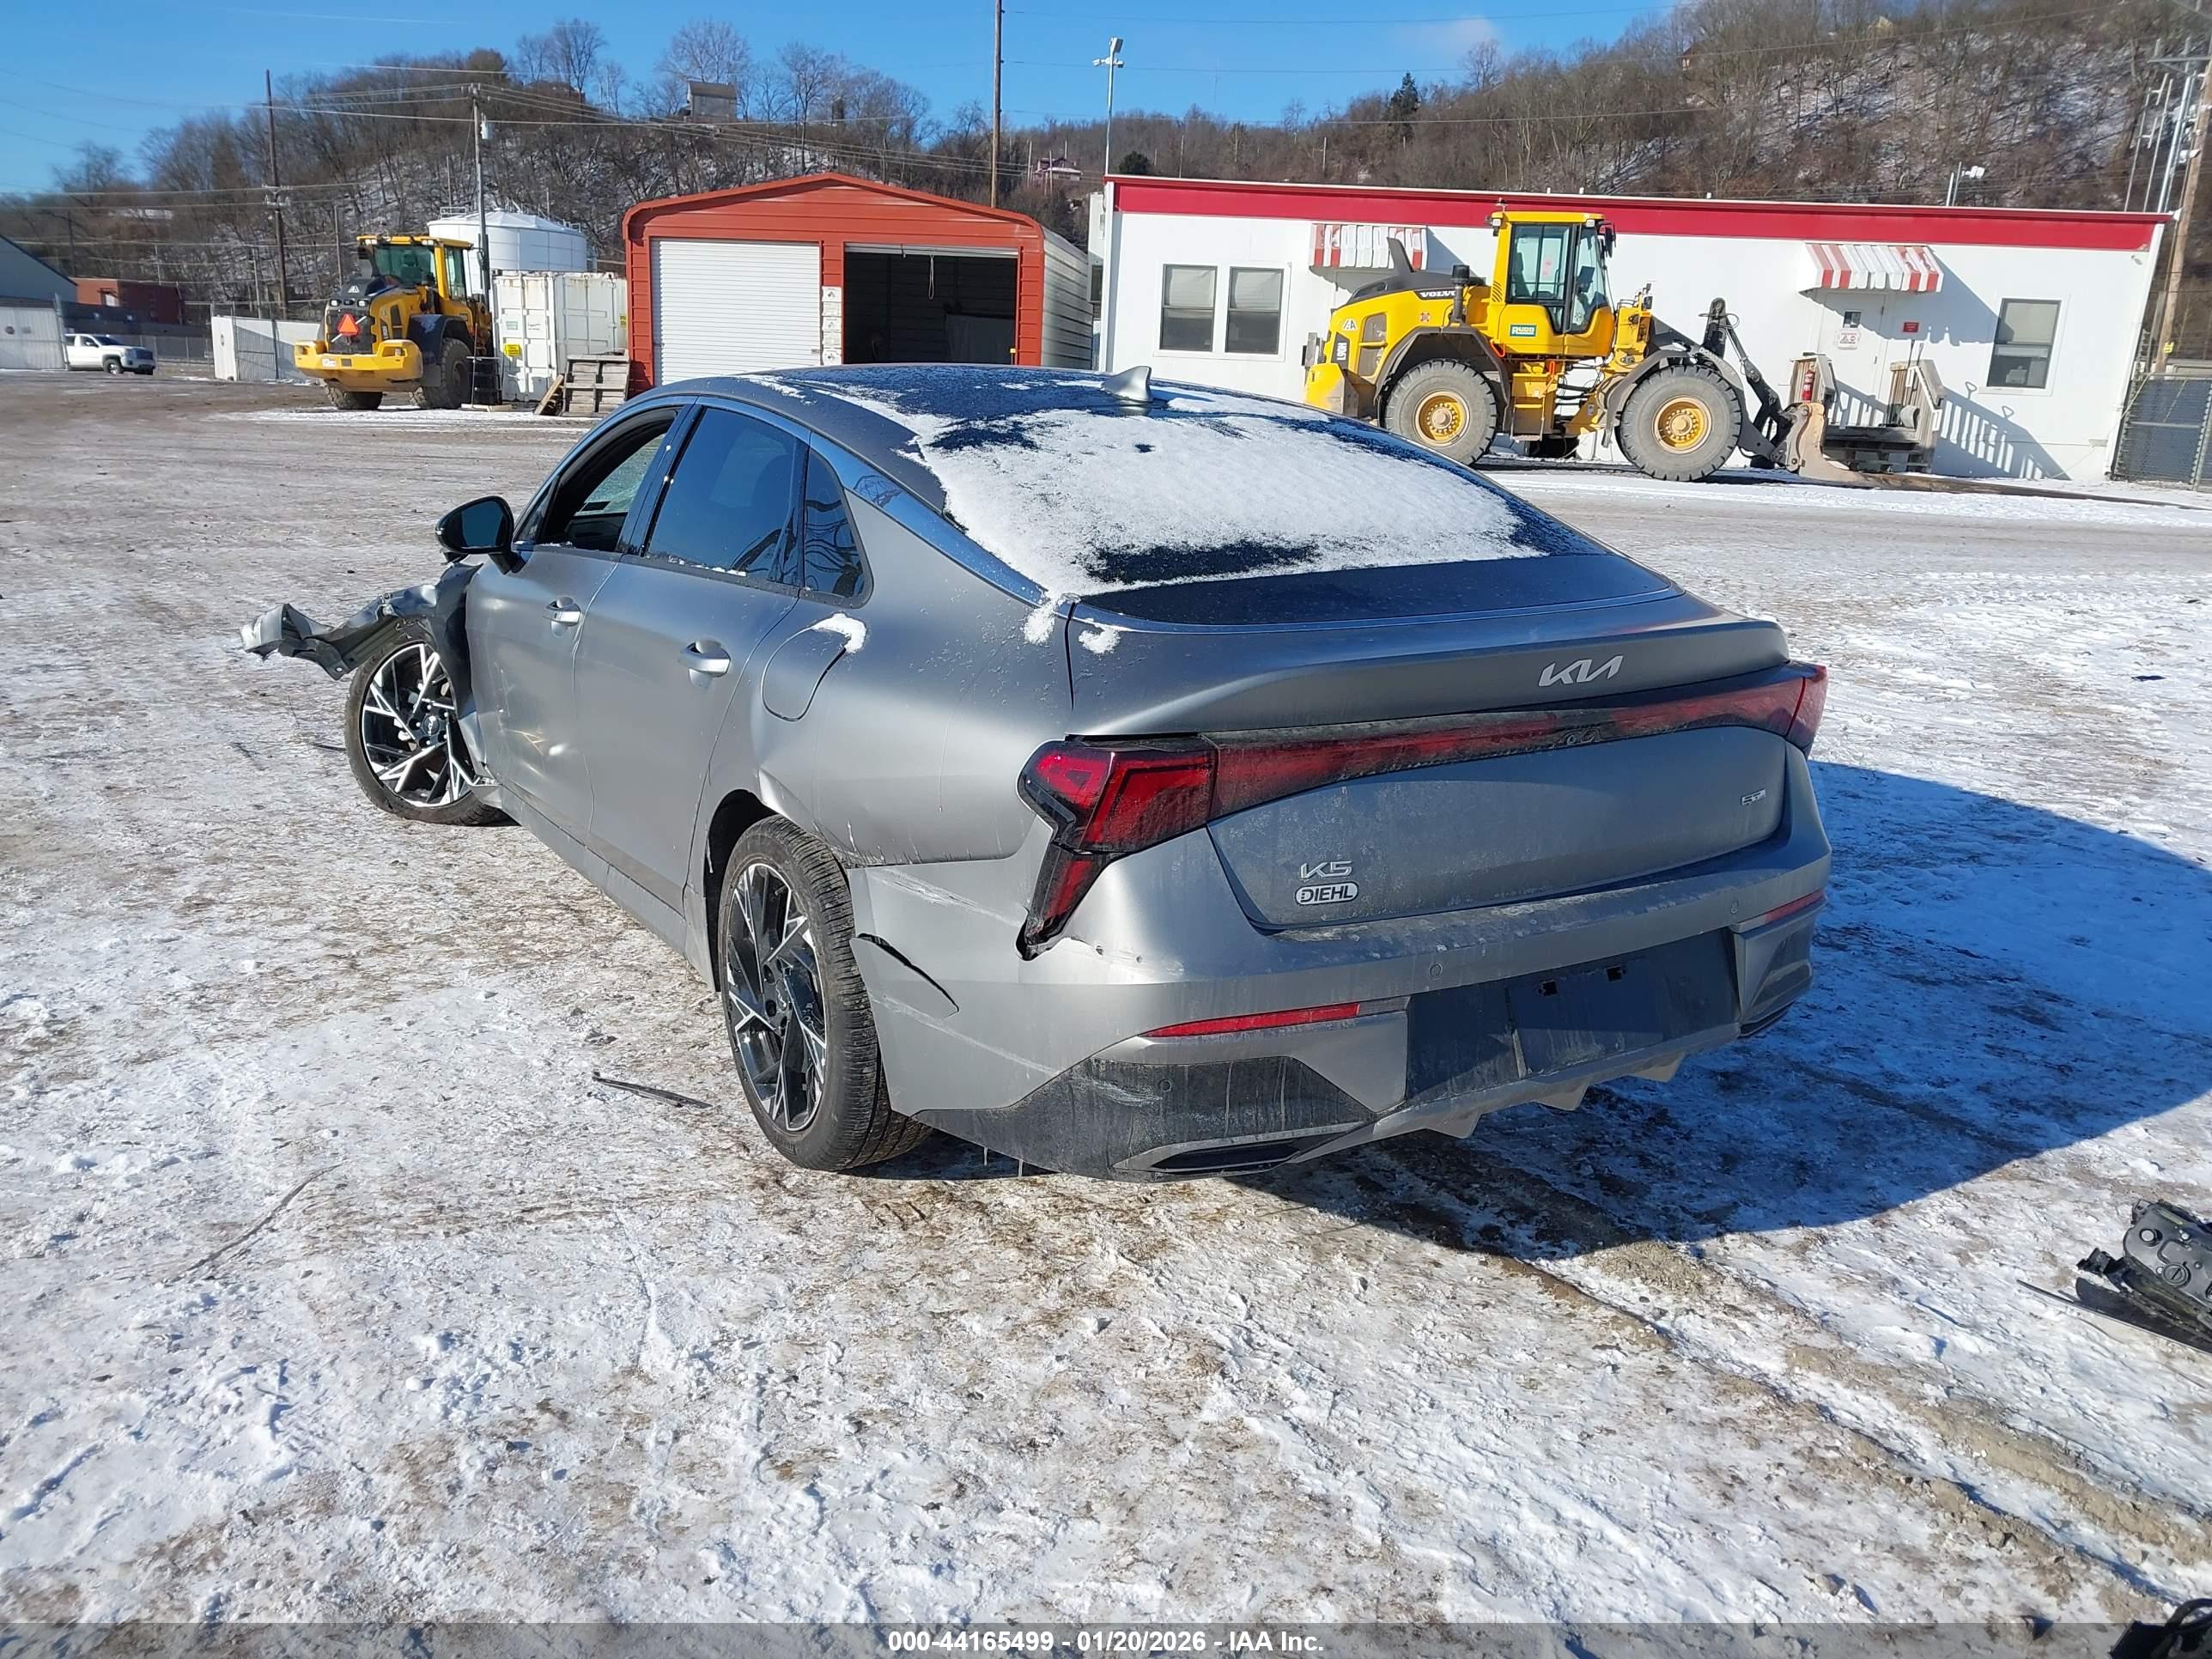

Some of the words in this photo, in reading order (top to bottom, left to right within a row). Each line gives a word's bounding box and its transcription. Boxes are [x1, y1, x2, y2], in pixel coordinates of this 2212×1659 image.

[1538, 655, 1624, 687] KIA
[1300, 860, 1352, 878] K5
[1300, 885, 1354, 903] DIEHL
